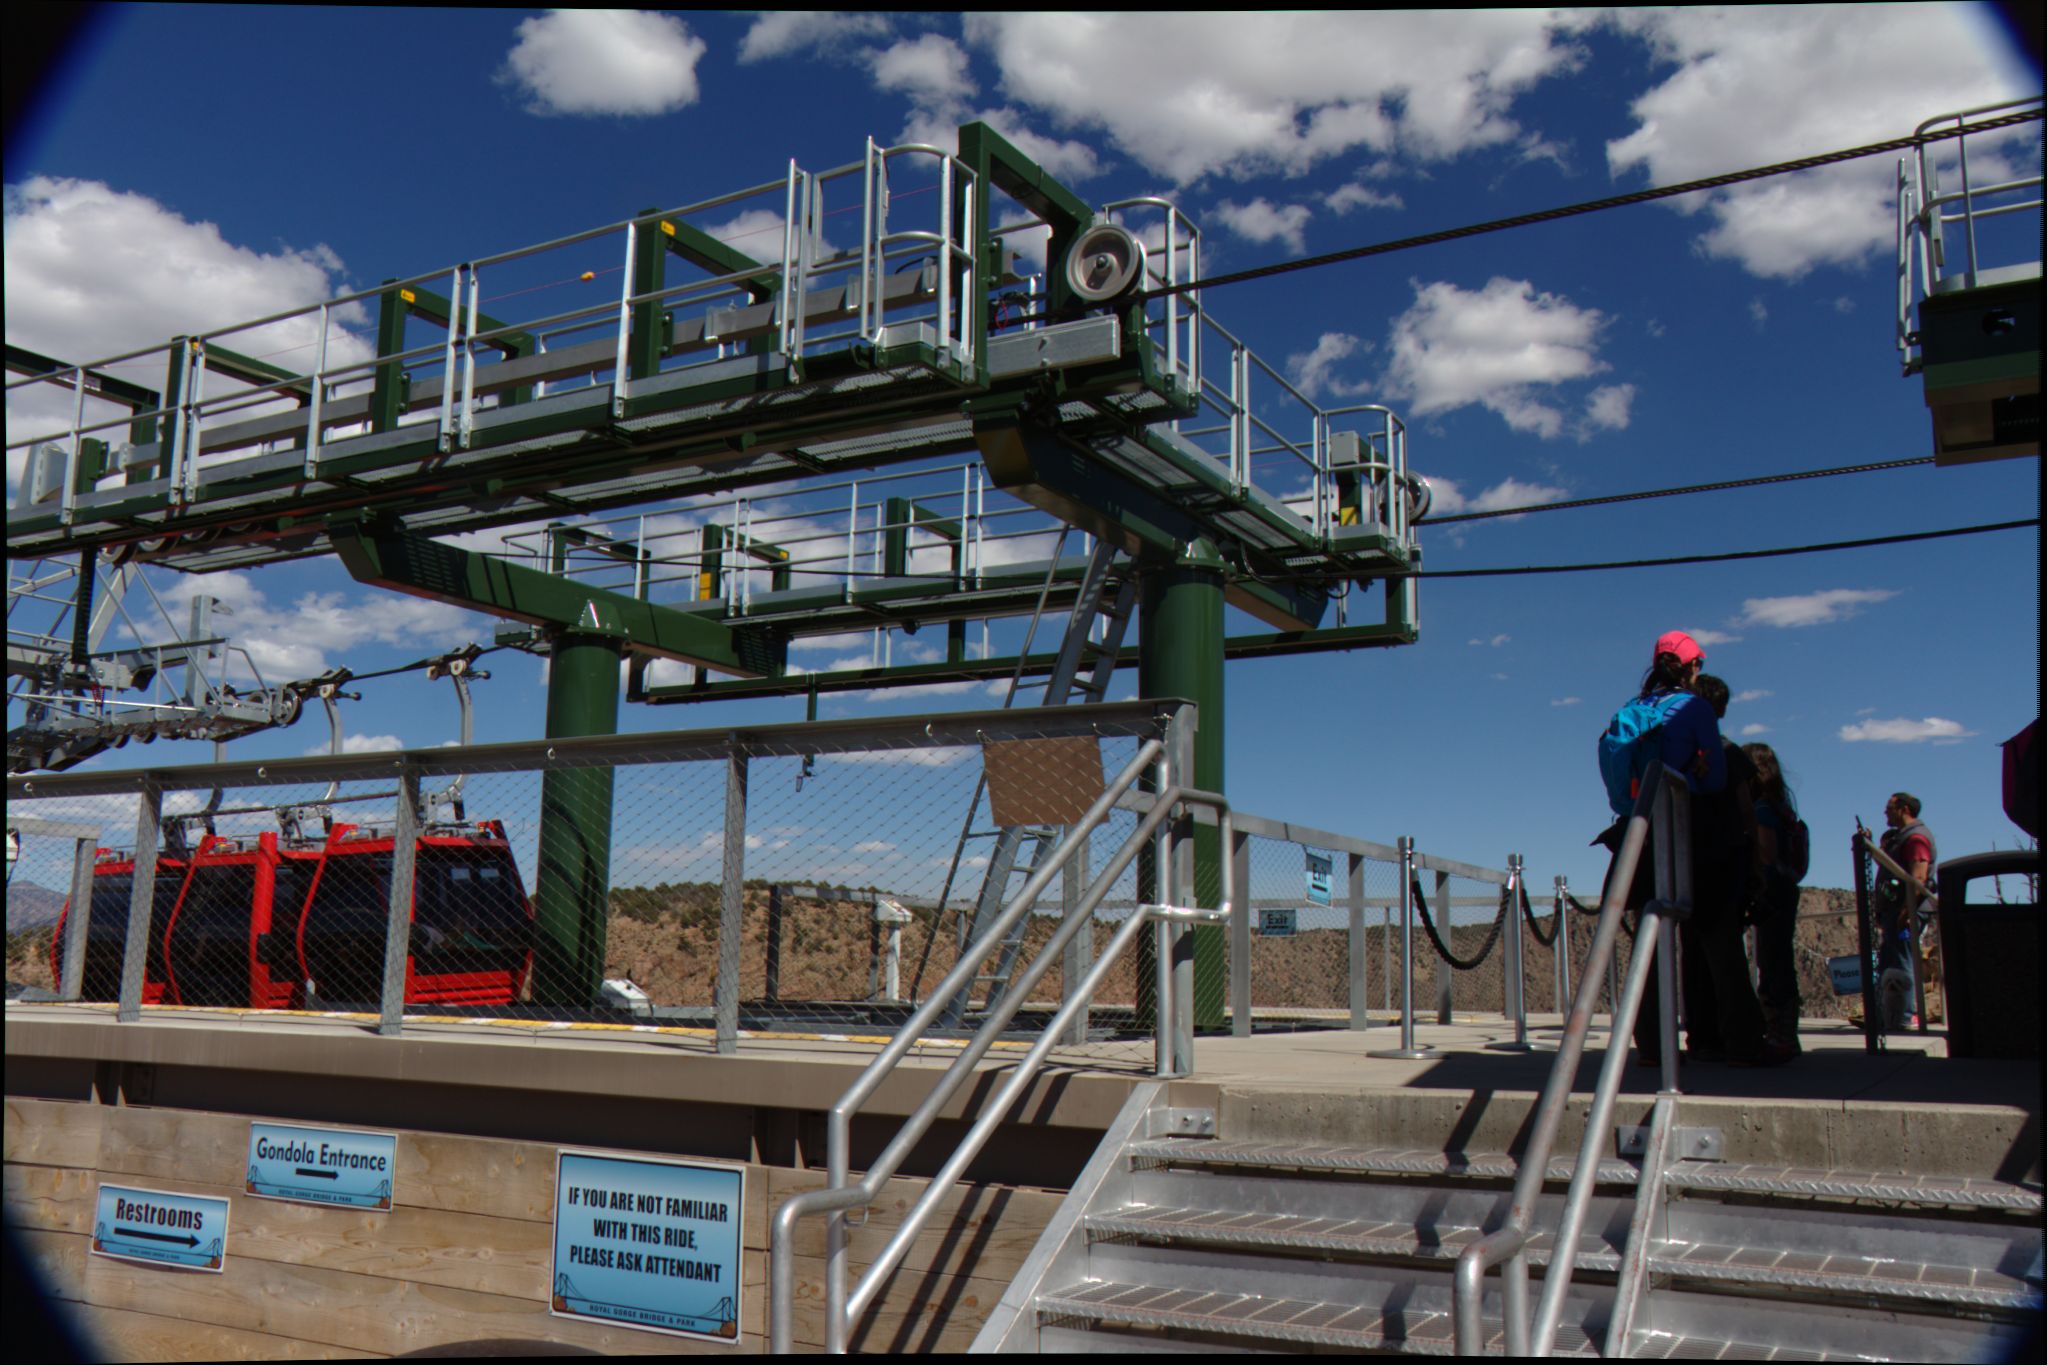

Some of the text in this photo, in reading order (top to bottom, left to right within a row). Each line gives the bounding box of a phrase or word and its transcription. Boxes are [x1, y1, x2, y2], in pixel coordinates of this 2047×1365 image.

[1312, 862, 1327, 885] Exit
[1267, 913, 1289, 925] Exit
[257, 1136, 387, 1171] Gondola Entrance
[116, 1197, 204, 1231] Restrooms
[568, 1186, 728, 1223] IF YOU ARE NOT FAMILIAR
[593, 1218, 698, 1251] WITH THIS RIDE,
[570, 1244, 722, 1283] PLEASE ASK ATTENDANT
[589, 1304, 696, 1328] ROYAL GORGE BRIDGE & PARK
